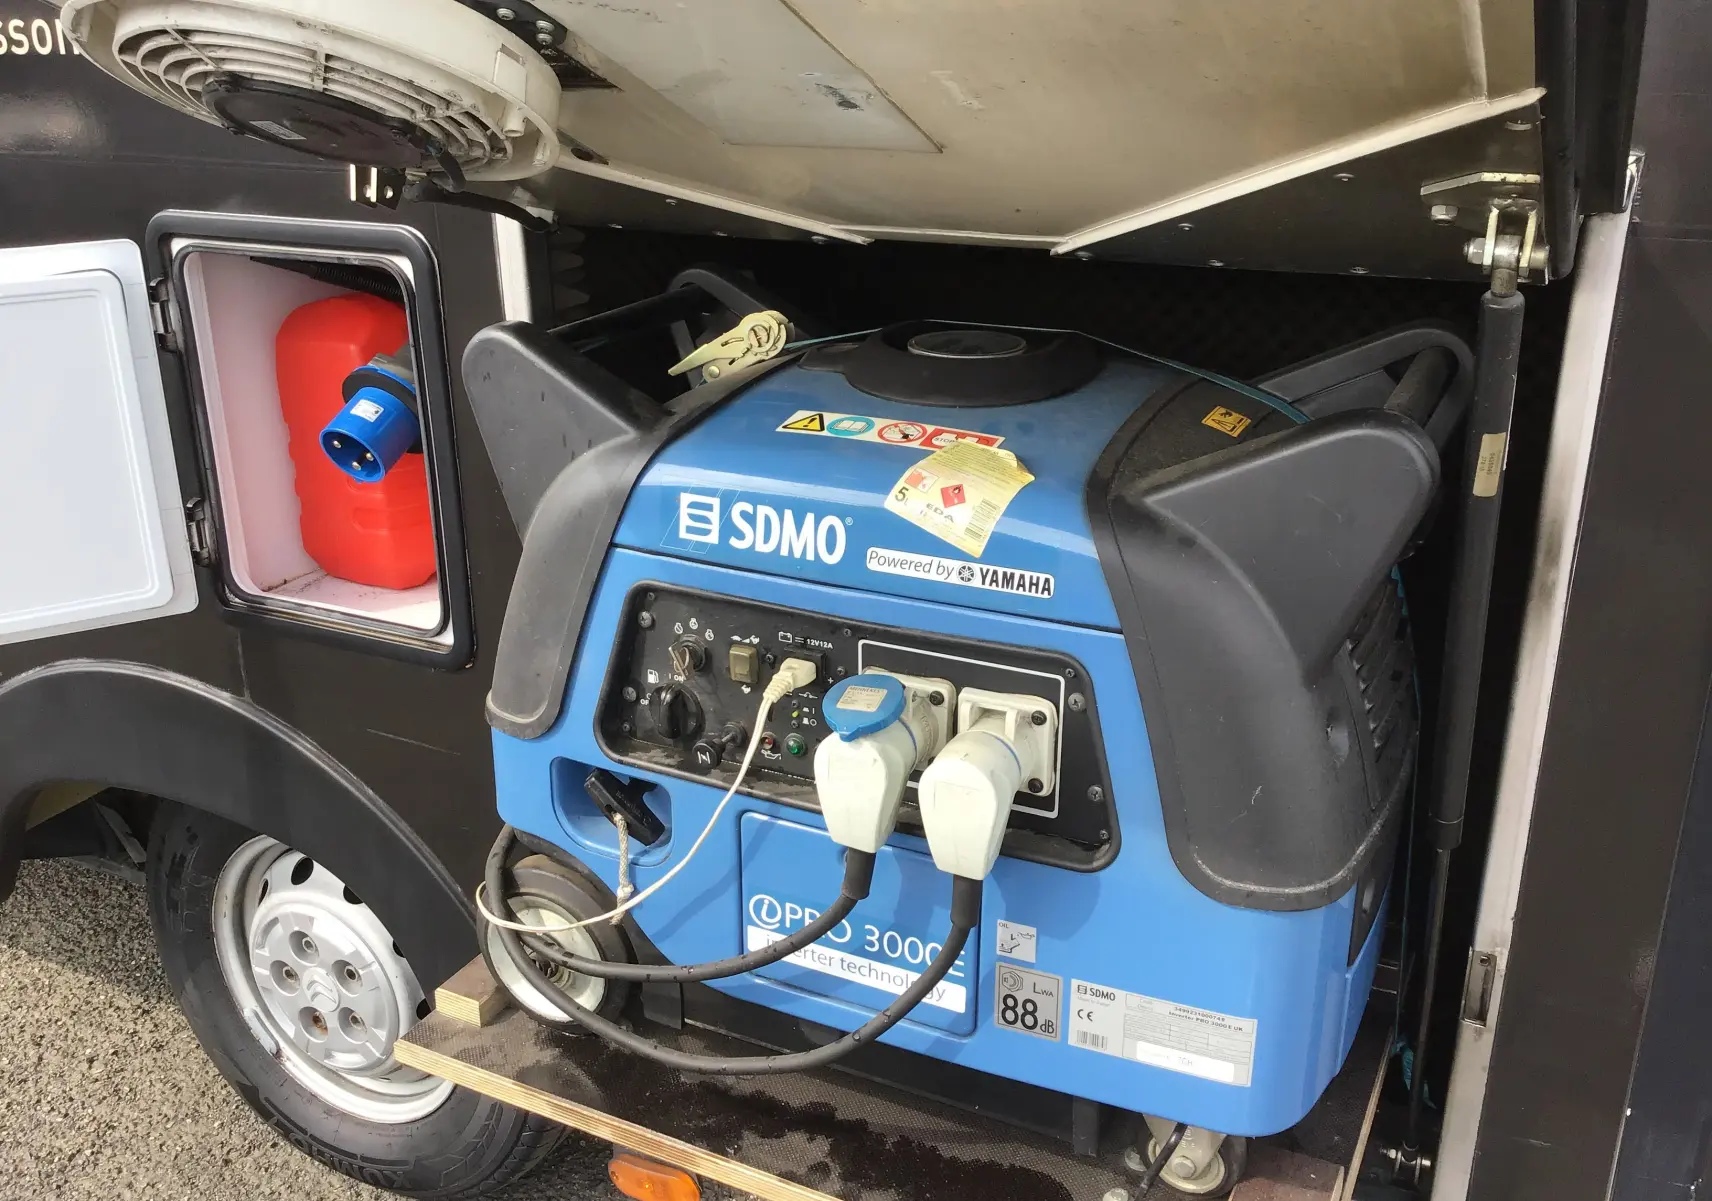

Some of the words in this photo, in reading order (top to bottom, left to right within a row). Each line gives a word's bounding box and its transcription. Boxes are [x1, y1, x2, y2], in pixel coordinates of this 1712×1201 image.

[728, 501, 846, 565] SDMO
[868, 550, 931, 574] Powered
[935, 560, 954, 580] by
[979, 566, 1052, 597] YAMAHA
[1001, 993, 1039, 1030] 88
[1040, 1018, 1055, 1034] dB
[1089, 987, 1116, 1001] SDMO
